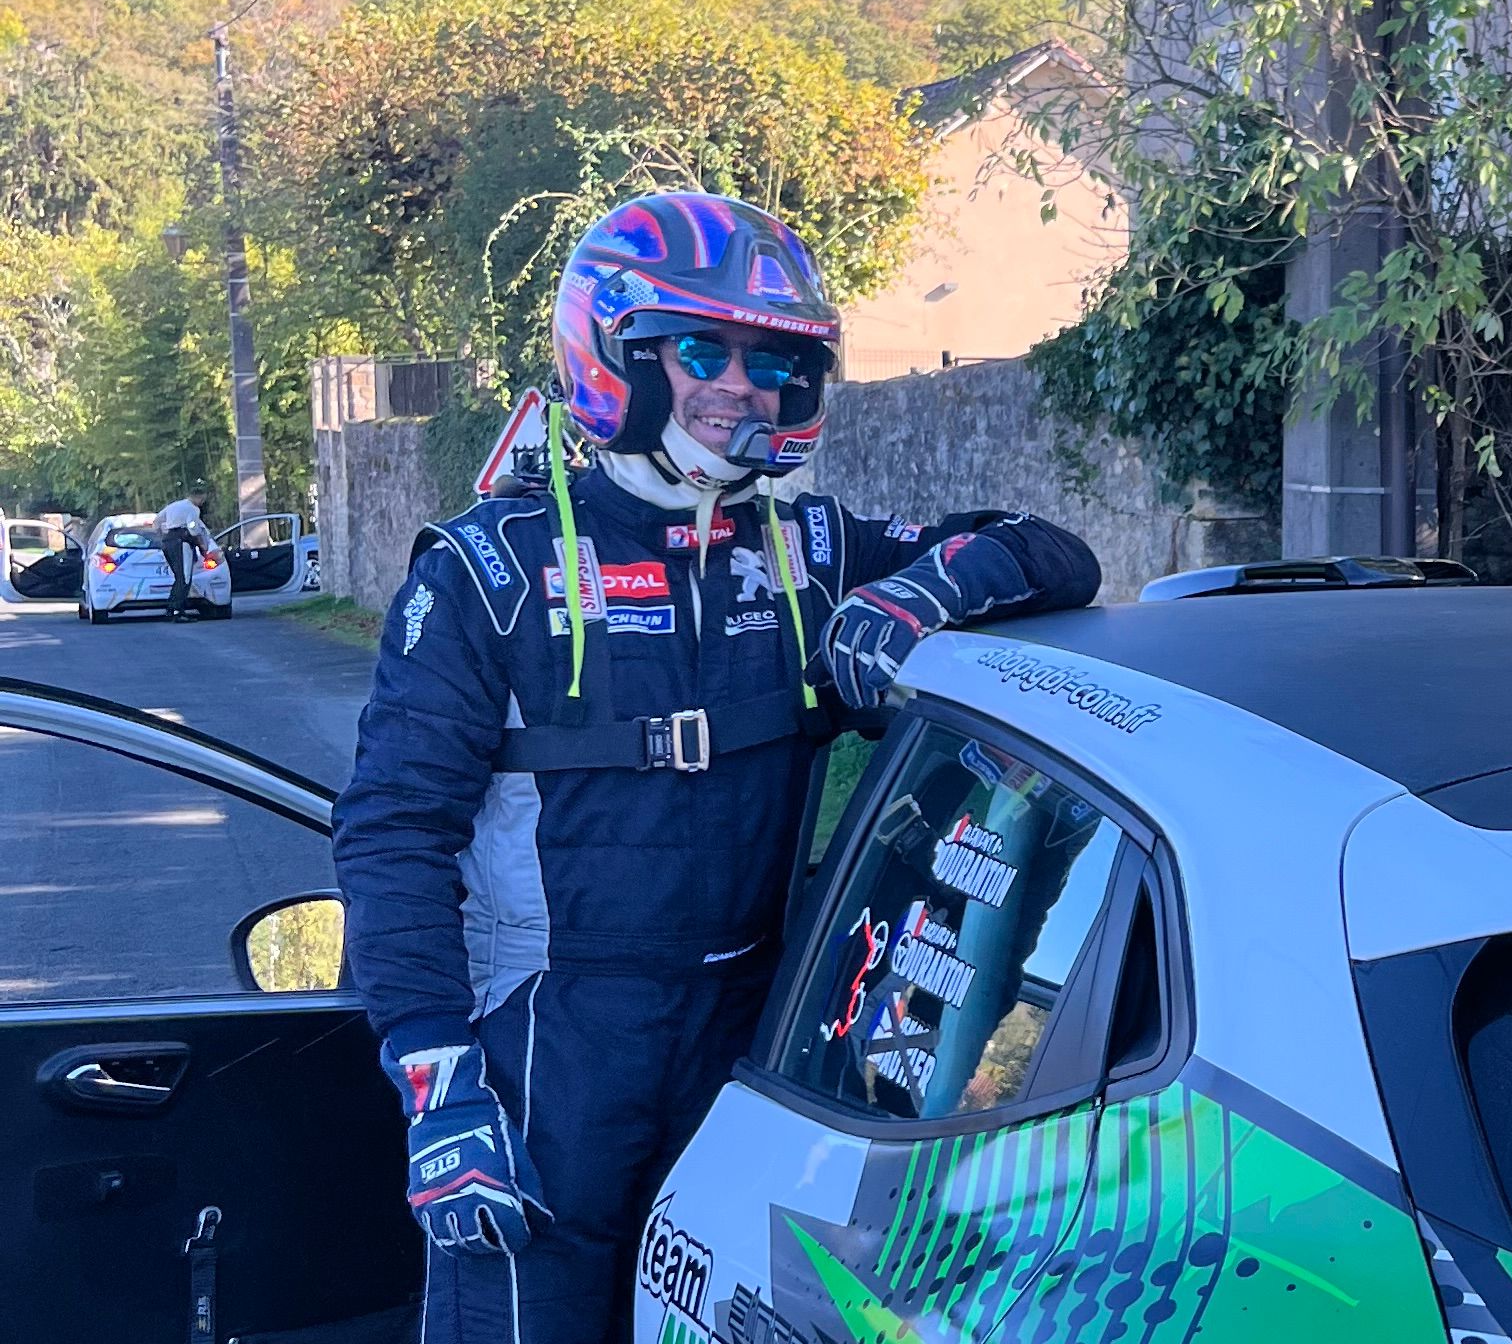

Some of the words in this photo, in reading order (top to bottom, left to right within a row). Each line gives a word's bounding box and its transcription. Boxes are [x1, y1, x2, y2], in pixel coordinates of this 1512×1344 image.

[688, 527, 734, 541] TTAL
[807, 506, 831, 563] sparco
[463, 524, 511, 586] sparco
[601, 573, 665, 590] OTAL
[607, 613, 663, 626] CHELIN
[642, 1209, 708, 1318] team
